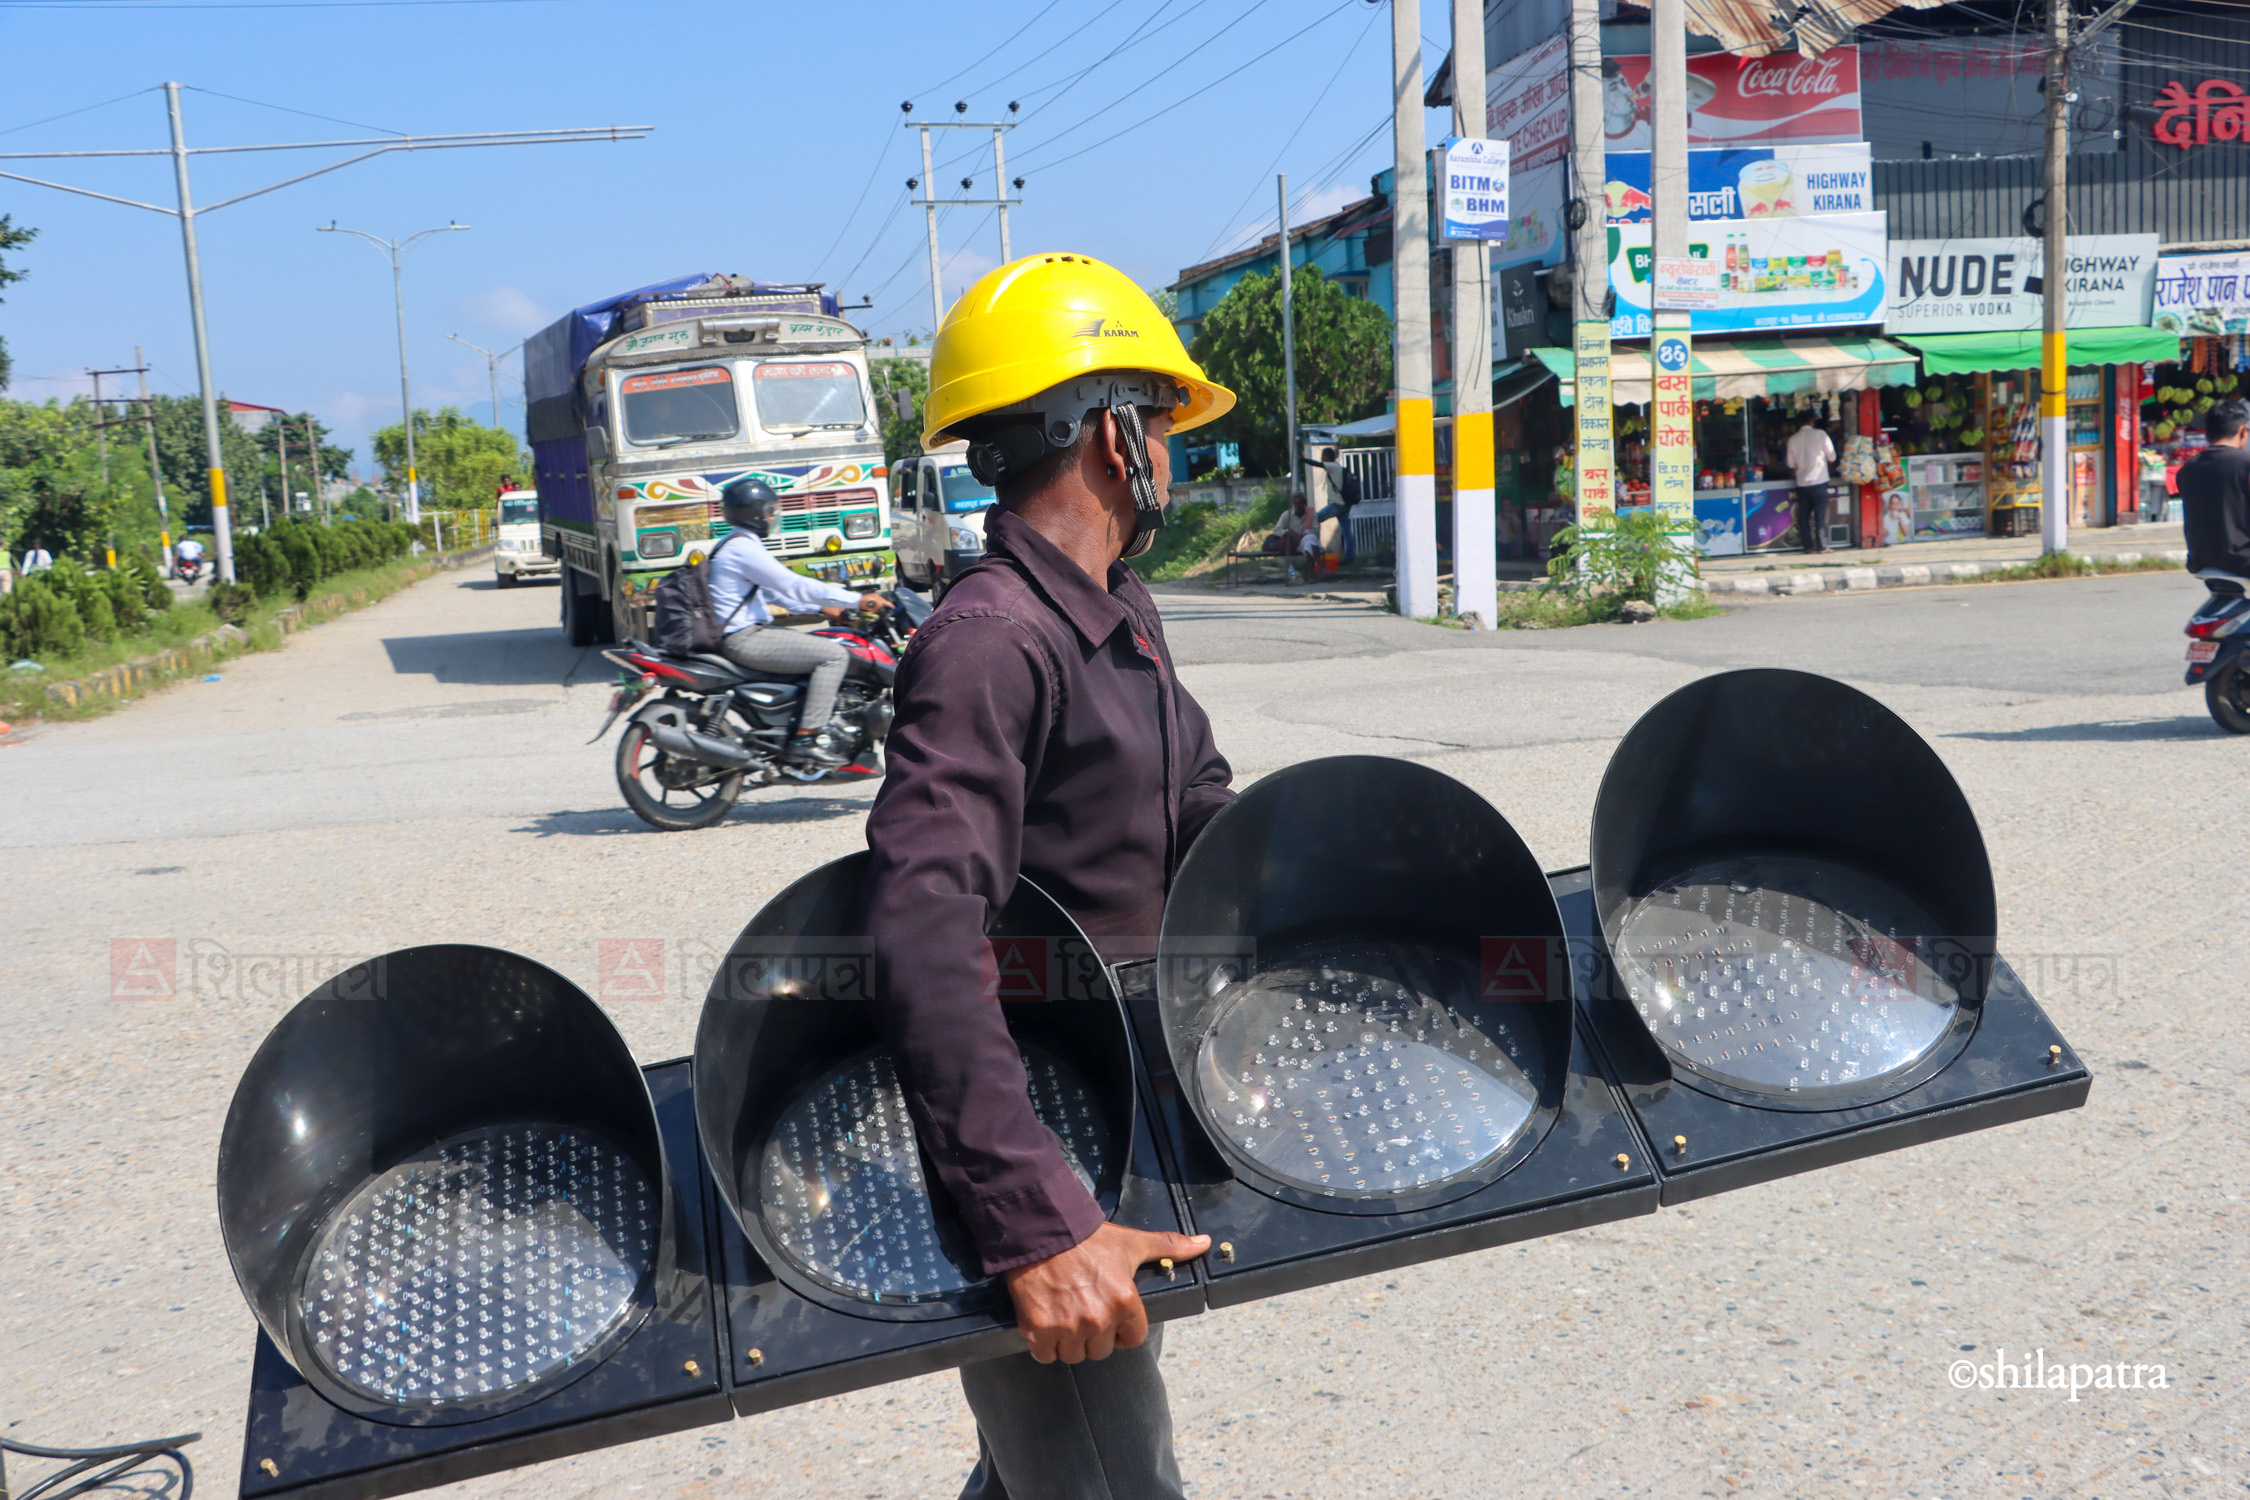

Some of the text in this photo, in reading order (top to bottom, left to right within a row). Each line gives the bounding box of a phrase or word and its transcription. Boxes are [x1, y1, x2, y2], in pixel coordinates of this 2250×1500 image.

[1450, 175, 1491, 192] BITM
[1807, 172, 1867, 191] HIGHWAY
[1466, 198, 1505, 213] BHM
[1688, 186, 1736, 216] सली
[1813, 194, 1862, 211] KIRANA
[2064, 255, 2140, 274] IGHWAY
[1899, 254, 2016, 298] NUDE
[2156, 267, 2202, 307] राजेश
[2208, 275, 2239, 303] पान
[1897, 301, 2013, 318] SUPERIOR VODKA
[1104, 329, 1139, 337] KARAM
[1657, 375, 1689, 391] बस
[1658, 394, 1691, 417] पार्क
